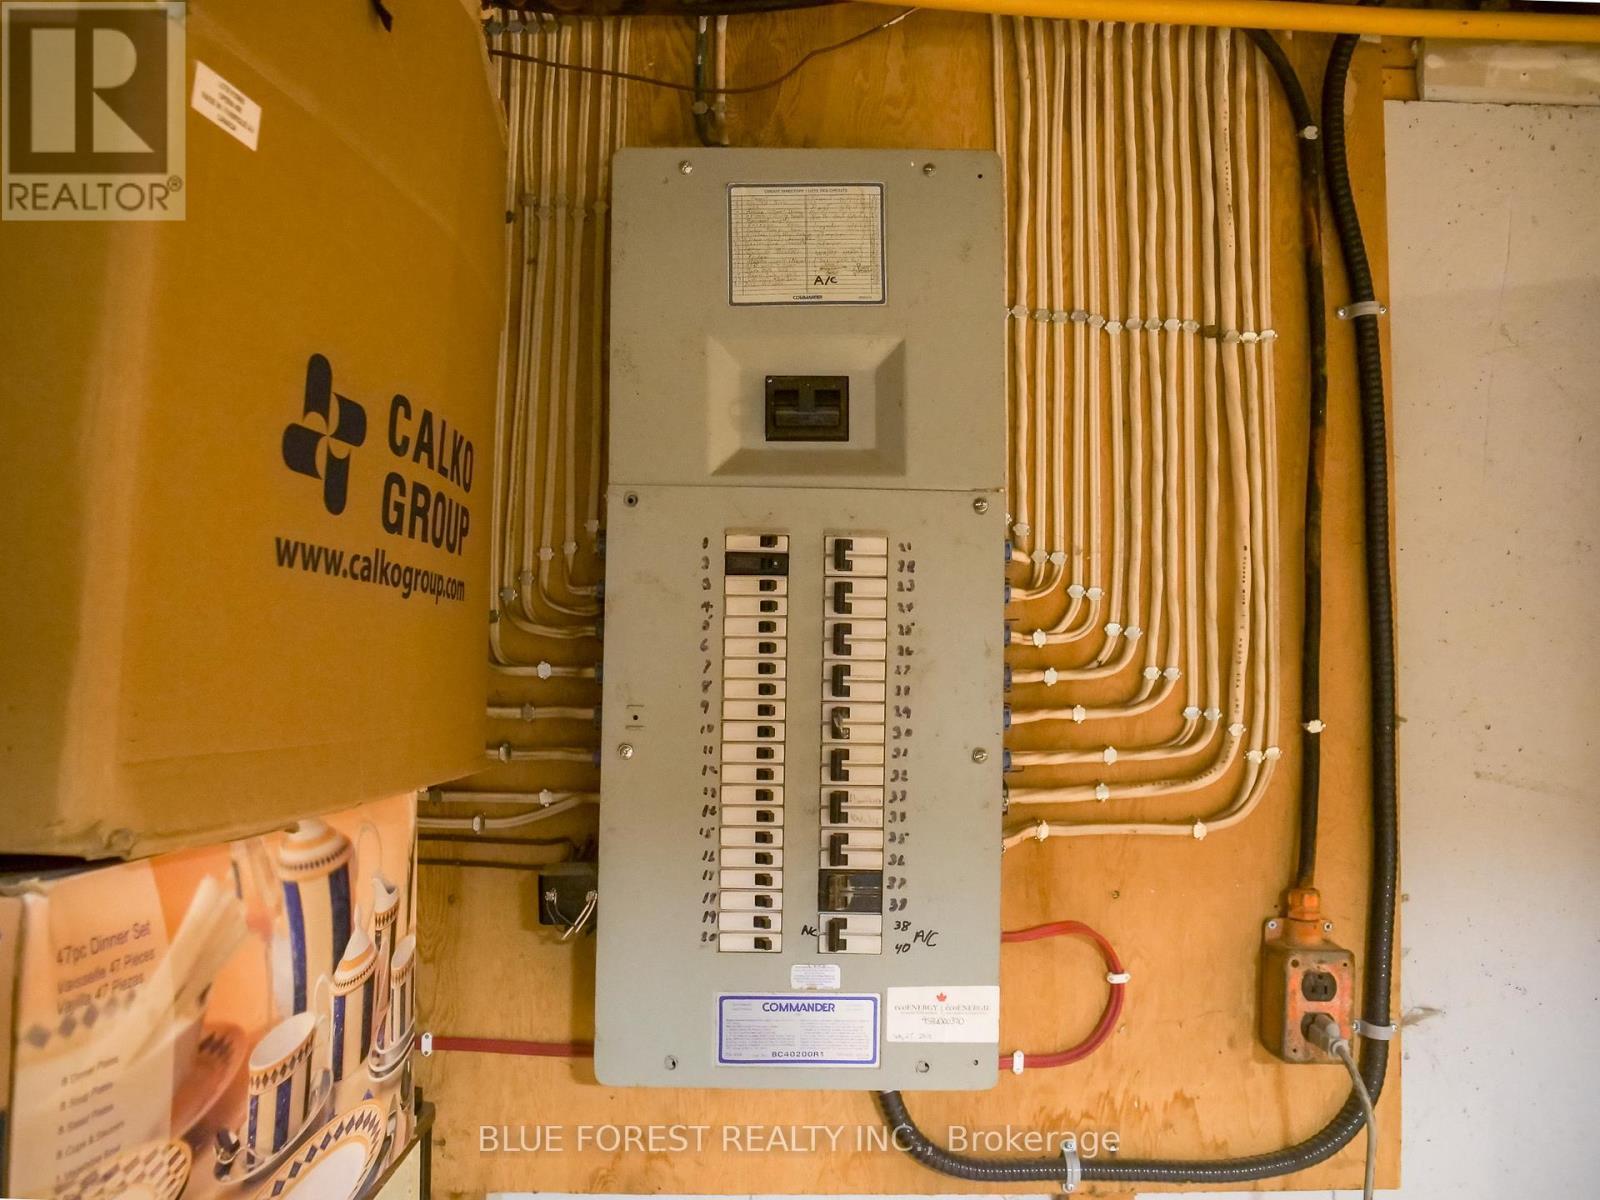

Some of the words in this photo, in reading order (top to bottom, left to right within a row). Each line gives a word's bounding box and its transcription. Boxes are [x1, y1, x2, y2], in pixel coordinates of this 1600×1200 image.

[813, 275, 838, 286] A/C
[388, 394, 474, 493] CALKO
[381, 471, 470, 556] GROUP
[275, 536, 465, 605] www.calkogroup.com
[701, 600, 713, 614] 4
[700, 638, 709, 652] 6
[703, 659, 712, 674] 7
[702, 680, 712, 694] 8
[700, 700, 709, 714] 9
[893, 704, 912, 719] 29
[700, 723, 714, 735] 10
[892, 725, 913, 740] 30
[892, 747, 908, 759] 31
[702, 869, 714, 881] 17
[702, 911, 716, 924] 19
[893, 920, 912, 932] 38
[90, 929, 130, 956] Dinner
[132, 920, 151, 940] Set
[913, 929, 939, 948] A/C
[894, 942, 912, 955] 40
[762, 1002, 835, 1013] COMMANDER
